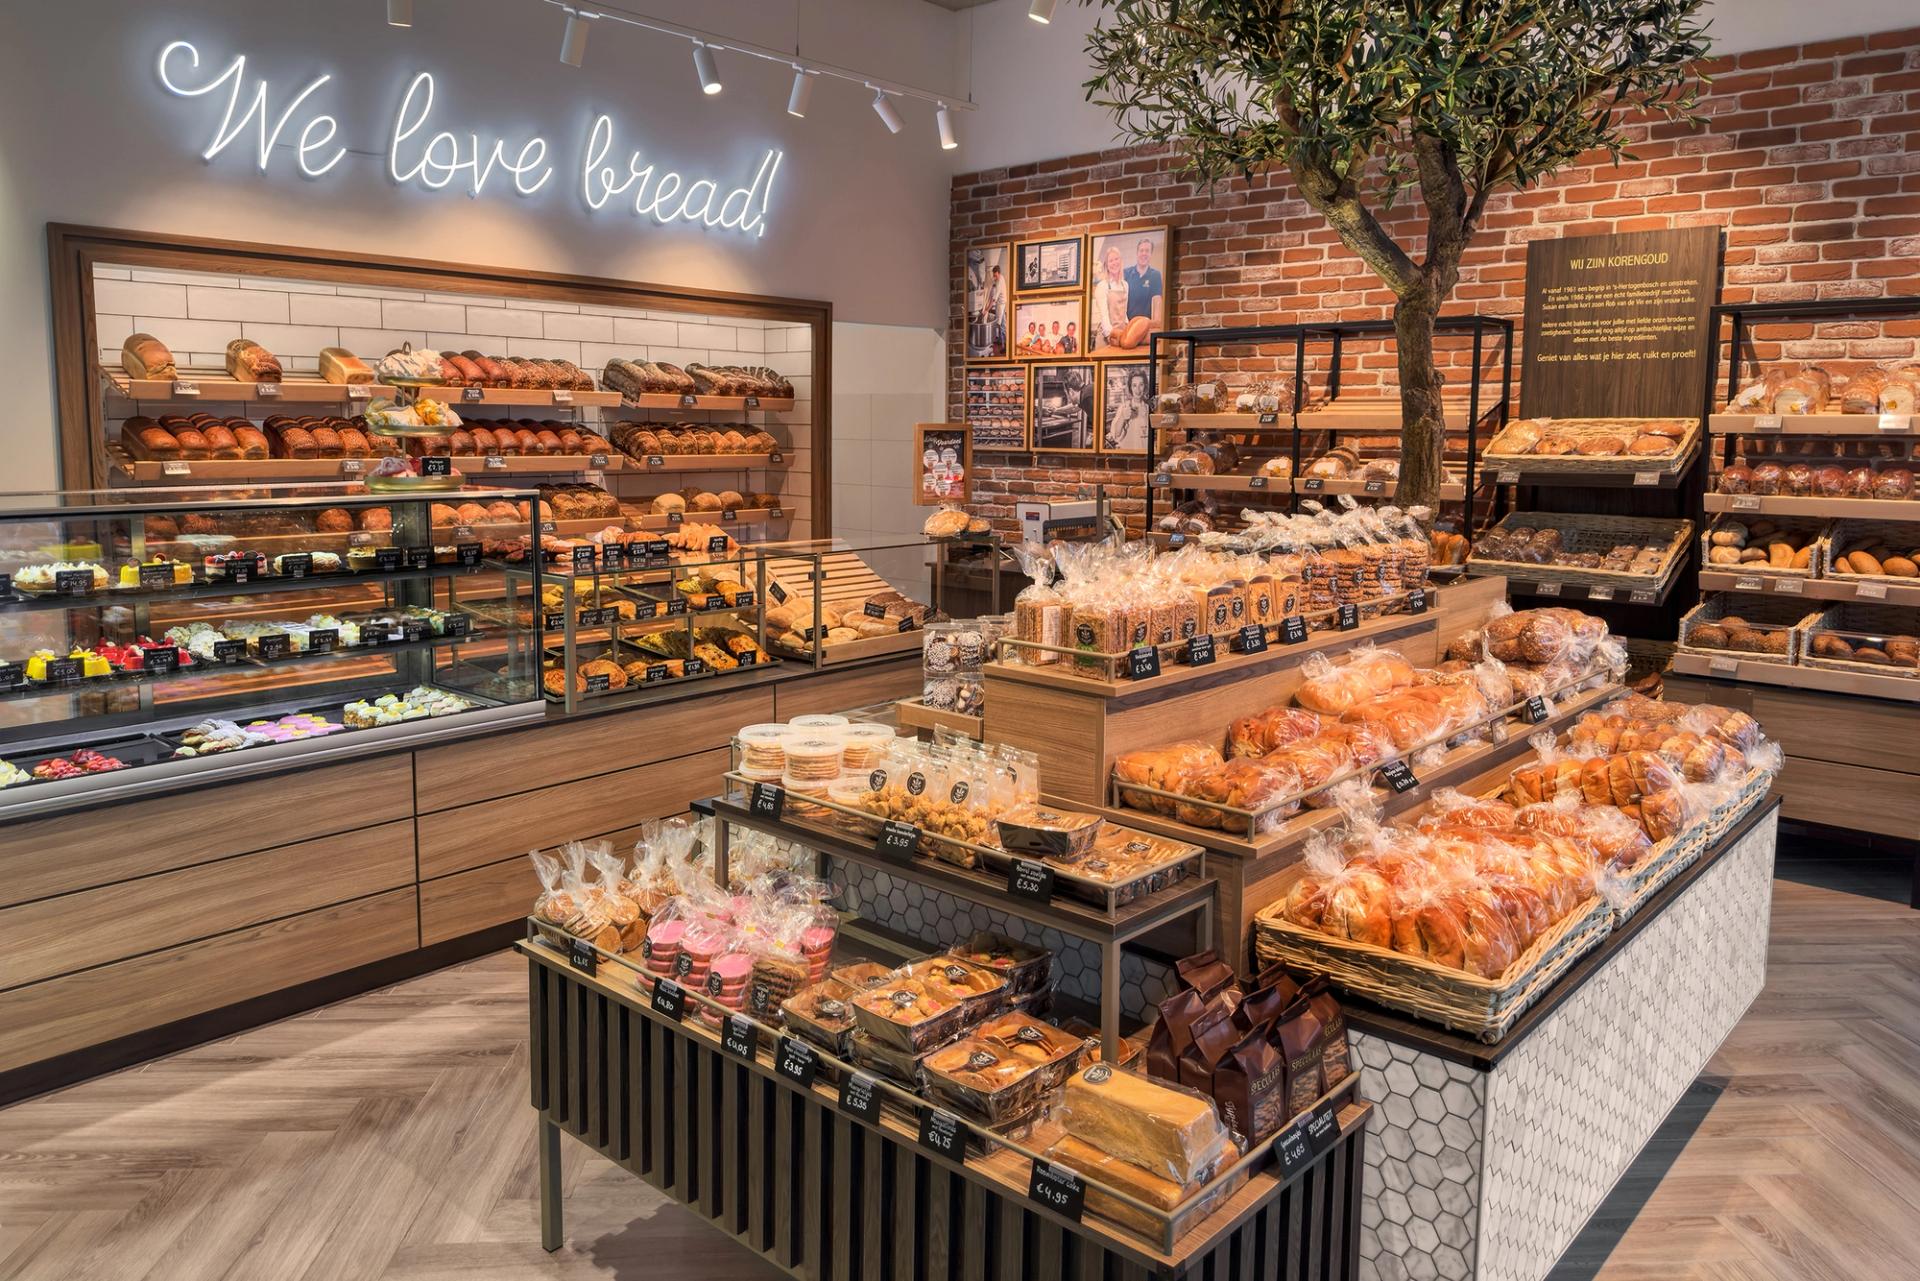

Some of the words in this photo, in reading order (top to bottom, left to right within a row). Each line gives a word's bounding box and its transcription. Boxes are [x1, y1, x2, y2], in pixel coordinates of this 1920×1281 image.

[159, 41, 346, 177] We
[390, 72, 553, 195] love
[584, 114, 784, 237] bread!
[1570, 259, 1584, 270] WIJ
[1586, 257, 1605, 269] ZIJN
[1607, 252, 1669, 267] KORENGOUD
[1537, 353, 1558, 362] Geniet
[1558, 354, 1572, 362] van
[1572, 352, 1588, 361] alles
[1589, 353, 1602, 361] wat
[1602, 352, 1610, 362] je
[1611, 351, 1625, 360] hier
[1642, 350, 1660, 360] ruikt
